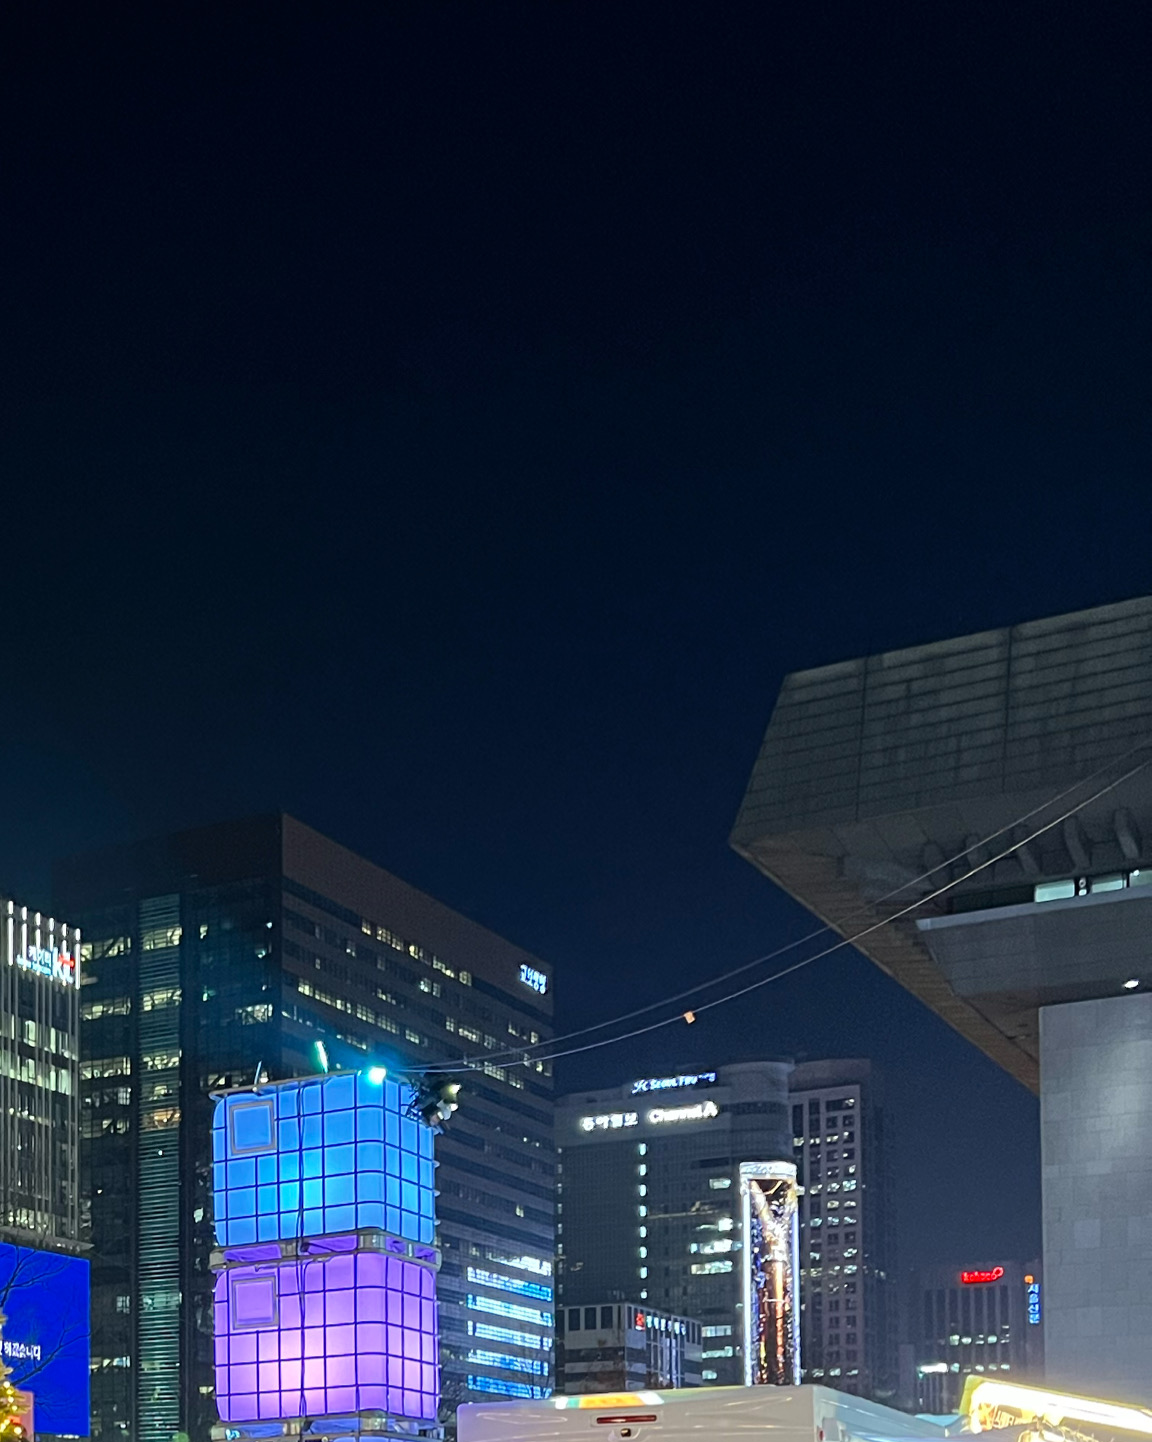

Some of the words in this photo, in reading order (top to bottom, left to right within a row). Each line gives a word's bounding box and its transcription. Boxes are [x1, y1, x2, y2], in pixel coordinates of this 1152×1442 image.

[520, 964, 547, 994] 교보생명
[582, 1112, 639, 1131] 동아일보
[649, 1104, 703, 1123] Channel
[703, 1101, 718, 1117] A
[1027, 1283, 1040, 1325] 서울신문
